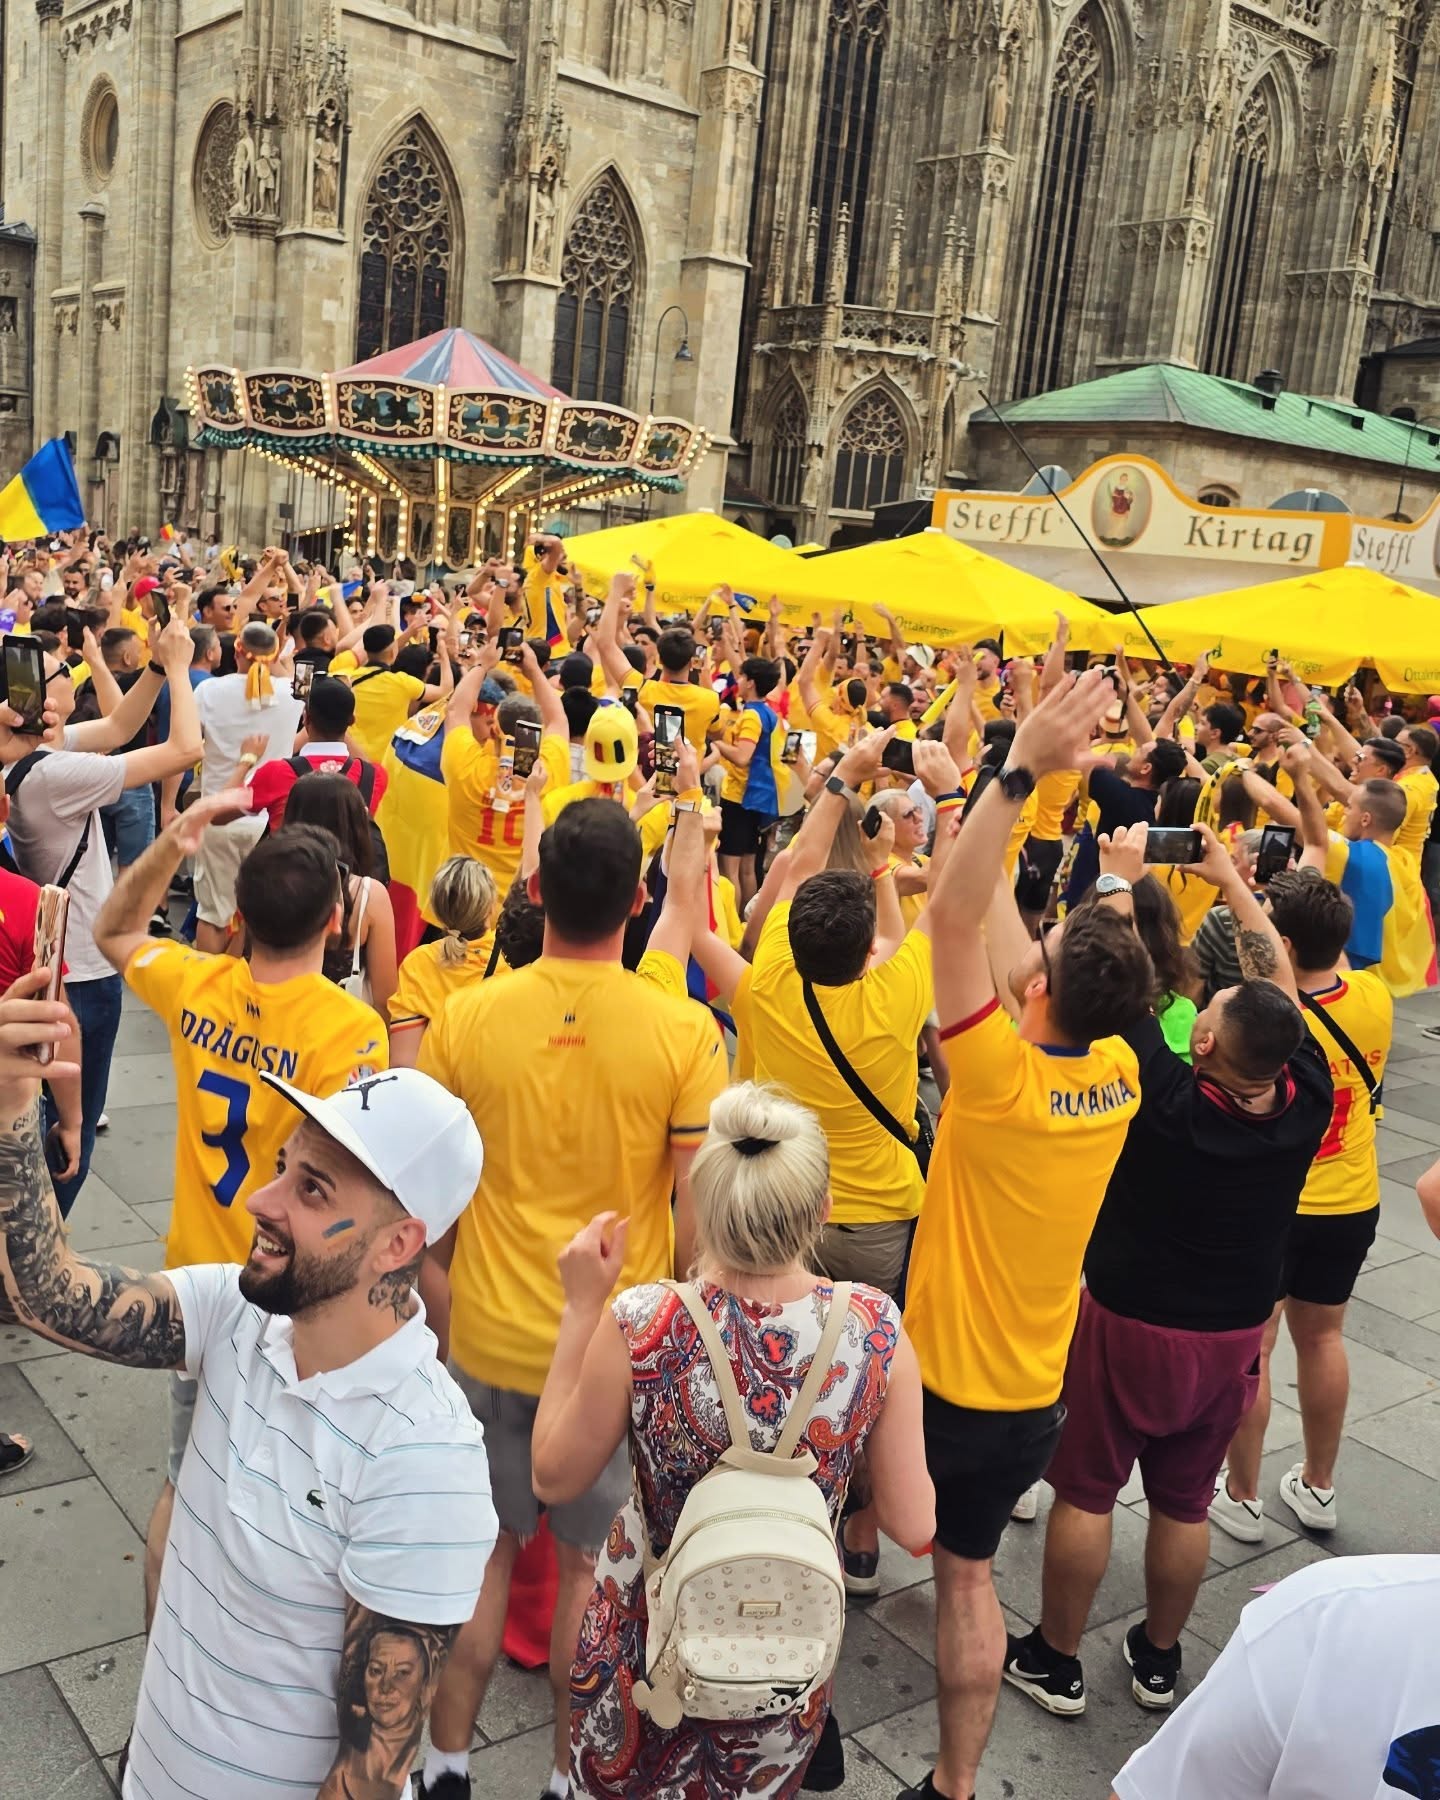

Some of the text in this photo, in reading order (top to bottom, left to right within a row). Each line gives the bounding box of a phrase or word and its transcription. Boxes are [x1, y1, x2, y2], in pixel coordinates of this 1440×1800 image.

[953, 501, 1315, 562] Steffl Kirtag
[1353, 527, 1415, 573] Steffl
